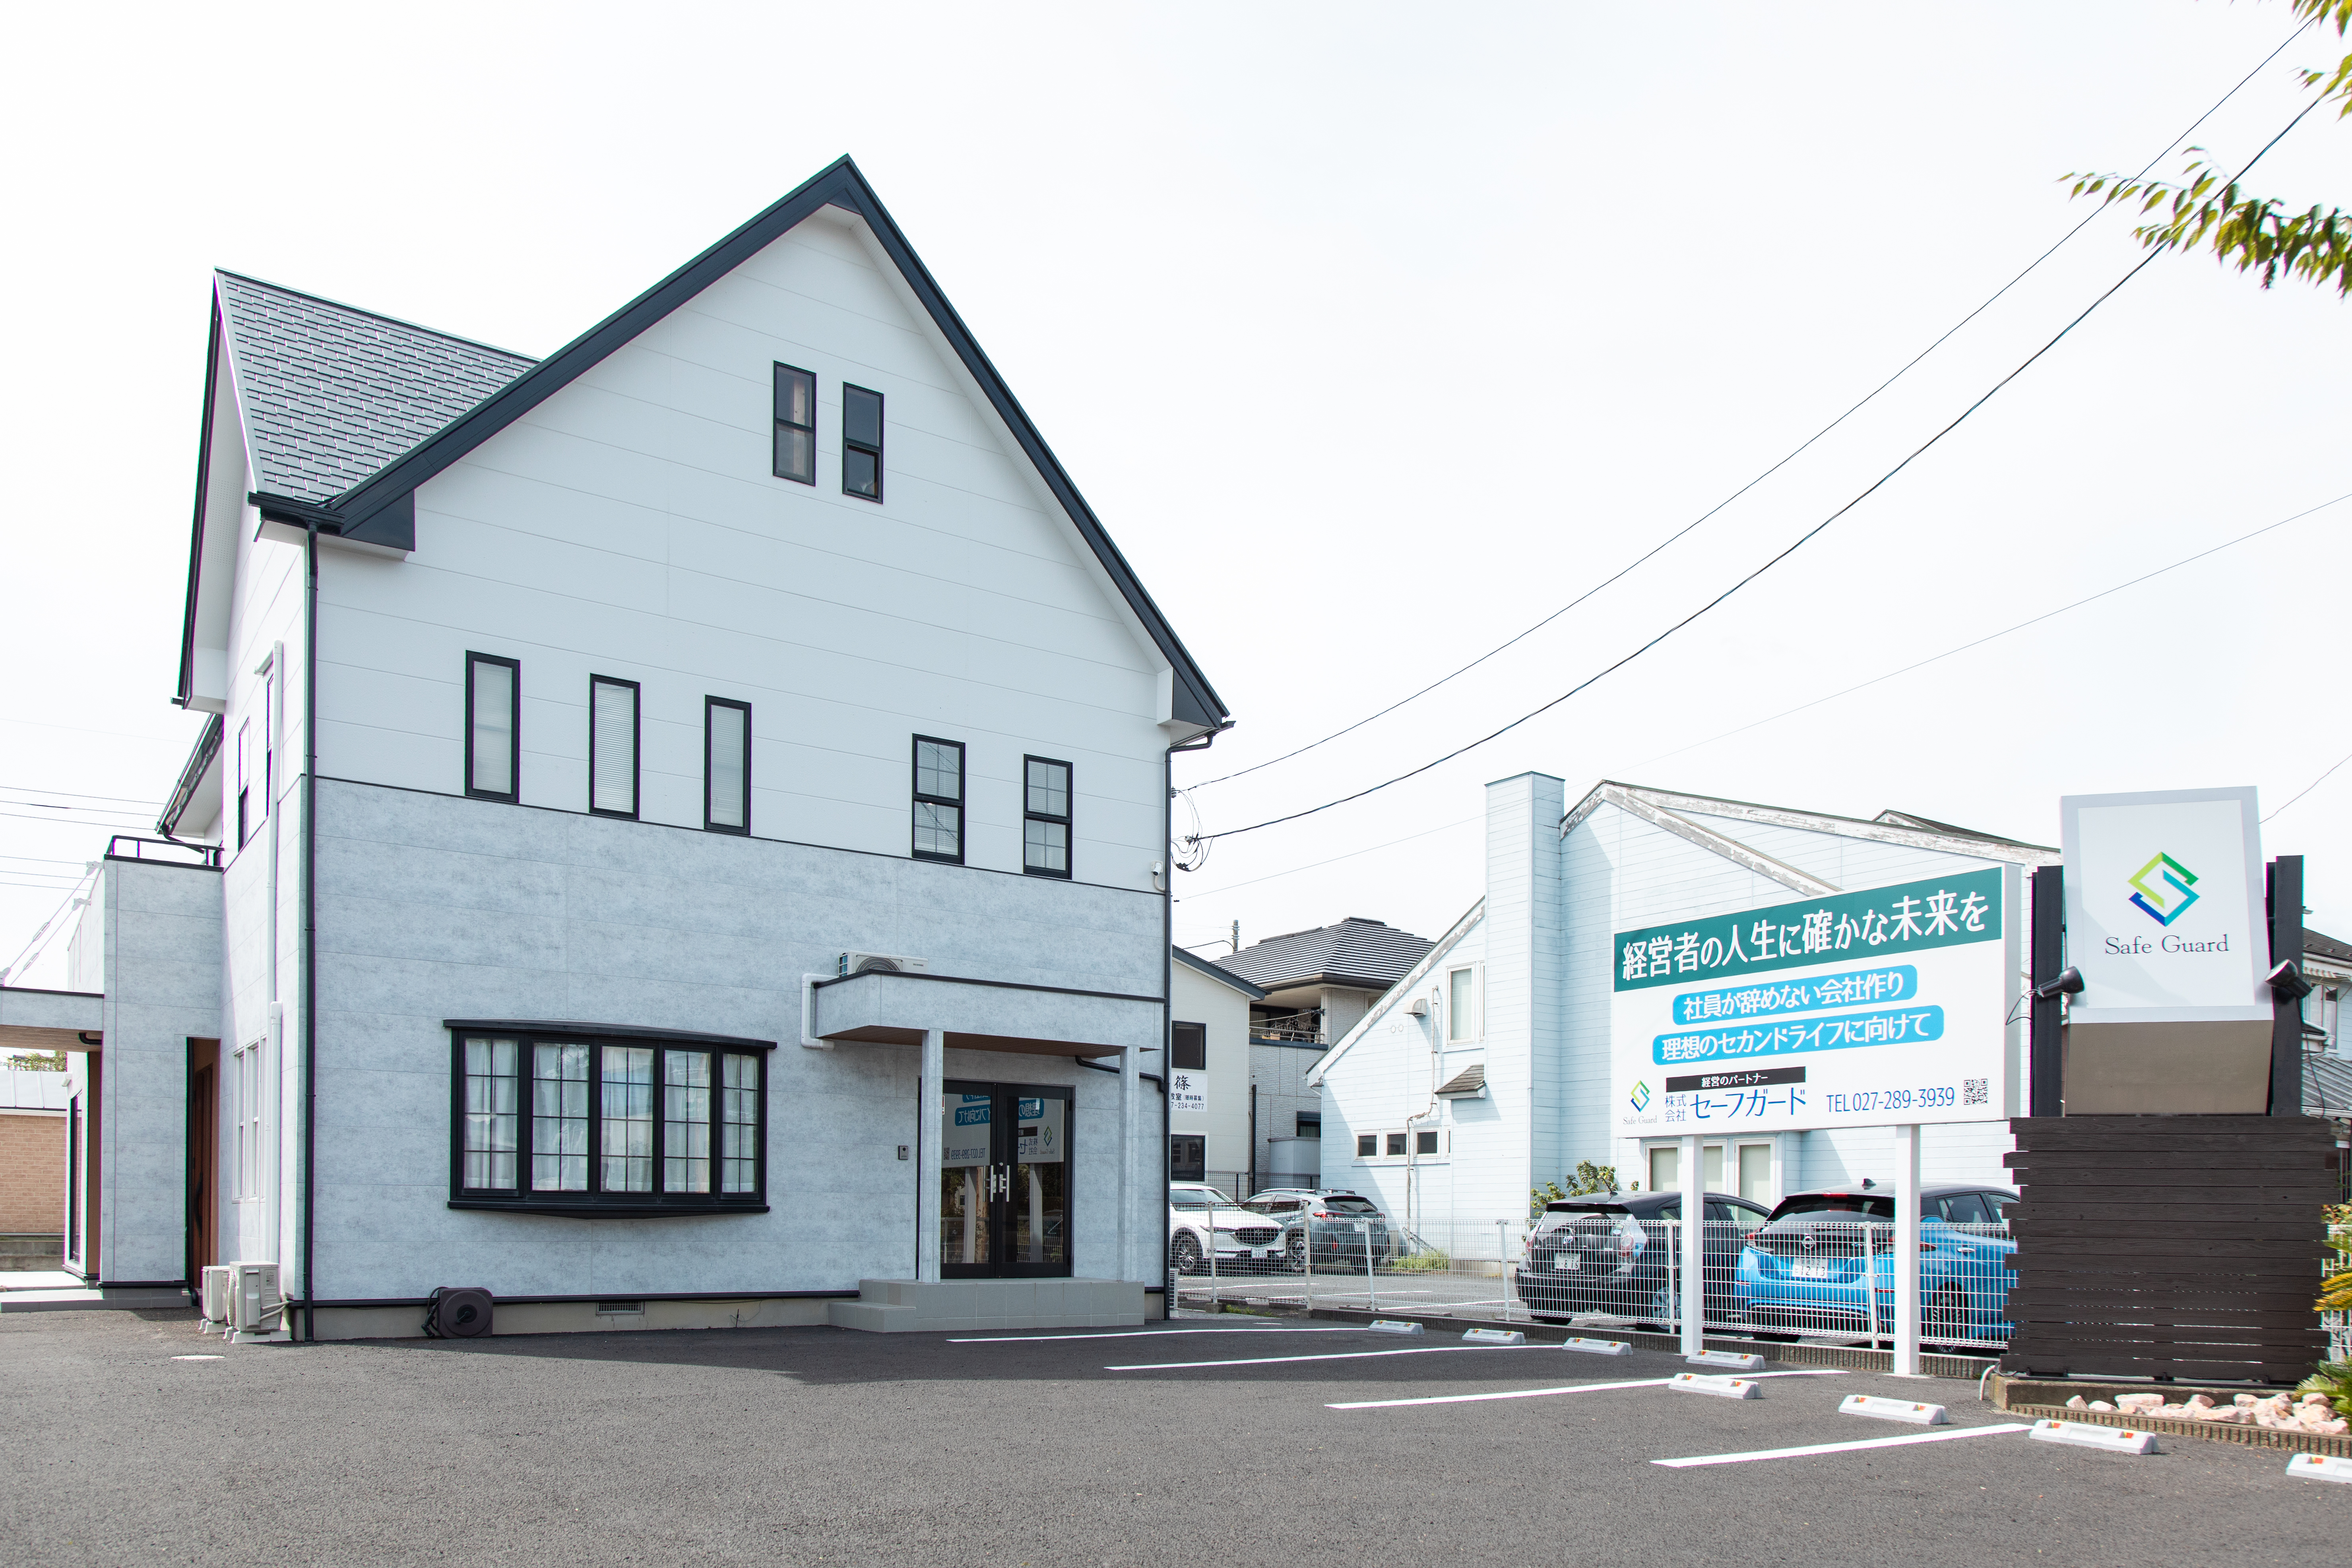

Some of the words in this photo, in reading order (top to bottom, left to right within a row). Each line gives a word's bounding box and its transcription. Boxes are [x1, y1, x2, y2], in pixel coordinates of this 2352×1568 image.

[1623, 890, 1989, 981] 経営者の人生に確かな未来を
[2105, 936, 2152, 955] Safe
[2161, 934, 2230, 953] Guard
[1683, 971, 1904, 1021] 社員が辞めない会社作り
[1662, 1013, 1931, 1060] 理想のセカンドライフに向けて
[1174, 1075, 1191, 1091] 篠
[1702, 1073, 1768, 1087] 経営のパートナー
[1665, 1094, 1686, 1108] 株式
[1689, 1087, 1806, 1119] セーフガード
[1623, 1116, 1636, 1125] Safe
[1638, 1115, 1657, 1124] Guard
[1665, 1109, 1686, 1122] 会社
